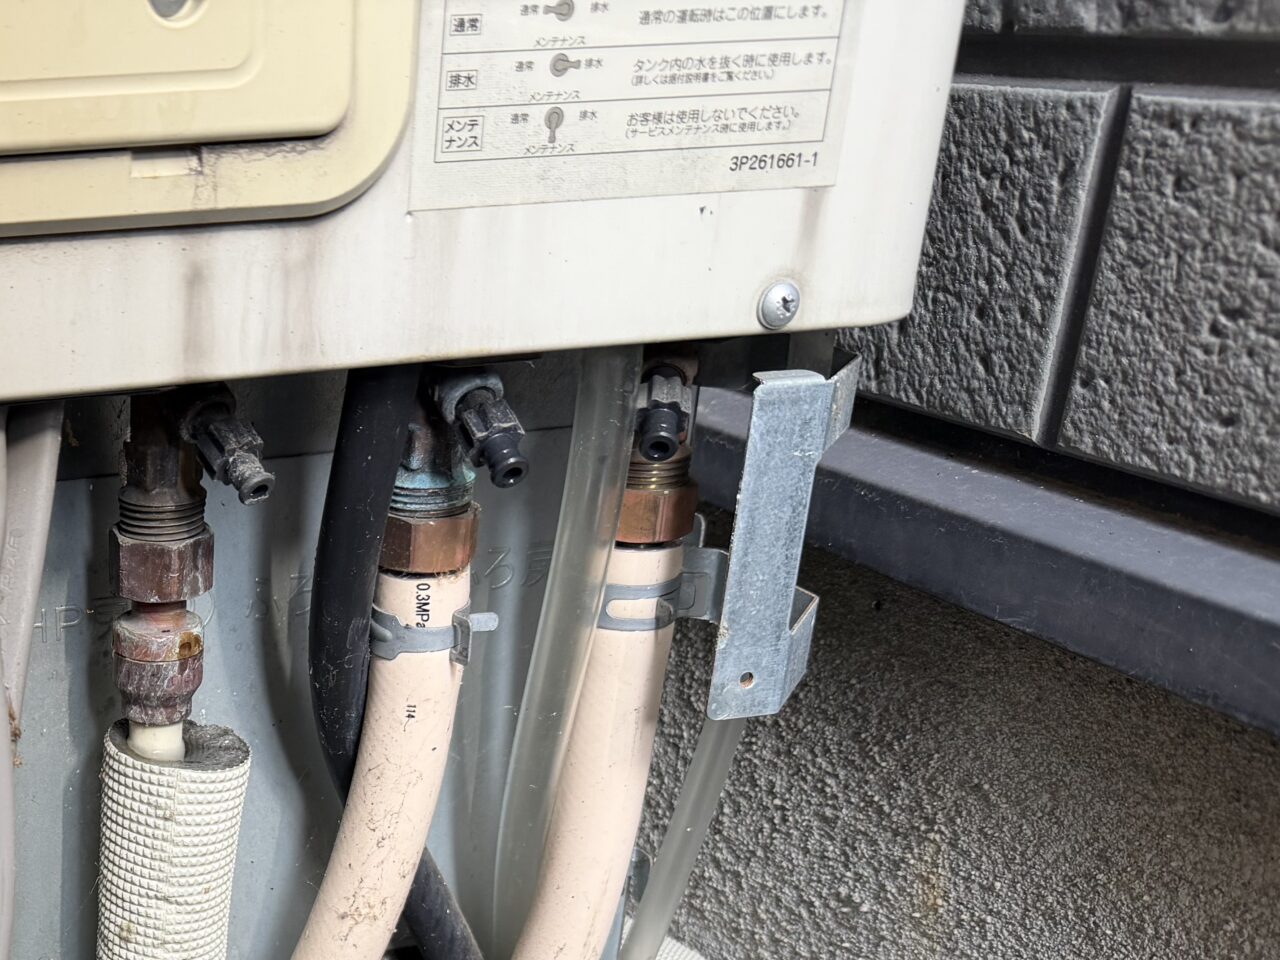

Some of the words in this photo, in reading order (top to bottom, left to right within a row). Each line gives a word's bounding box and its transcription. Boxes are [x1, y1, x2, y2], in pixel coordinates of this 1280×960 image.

[534, 36, 586, 47] メンテナンス
[448, 74, 476, 88] 排水
[529, 90, 581, 102] メンテナンス
[626, 106, 800, 127] お客様は使用しないでください。
[444, 119, 479, 133] メンテ
[445, 136, 479, 149] ナンス
[523, 144, 575, 155] メンテナンス
[729, 152, 819, 172] 3P261661-1
[415, 582, 431, 629] 0.3MPa
